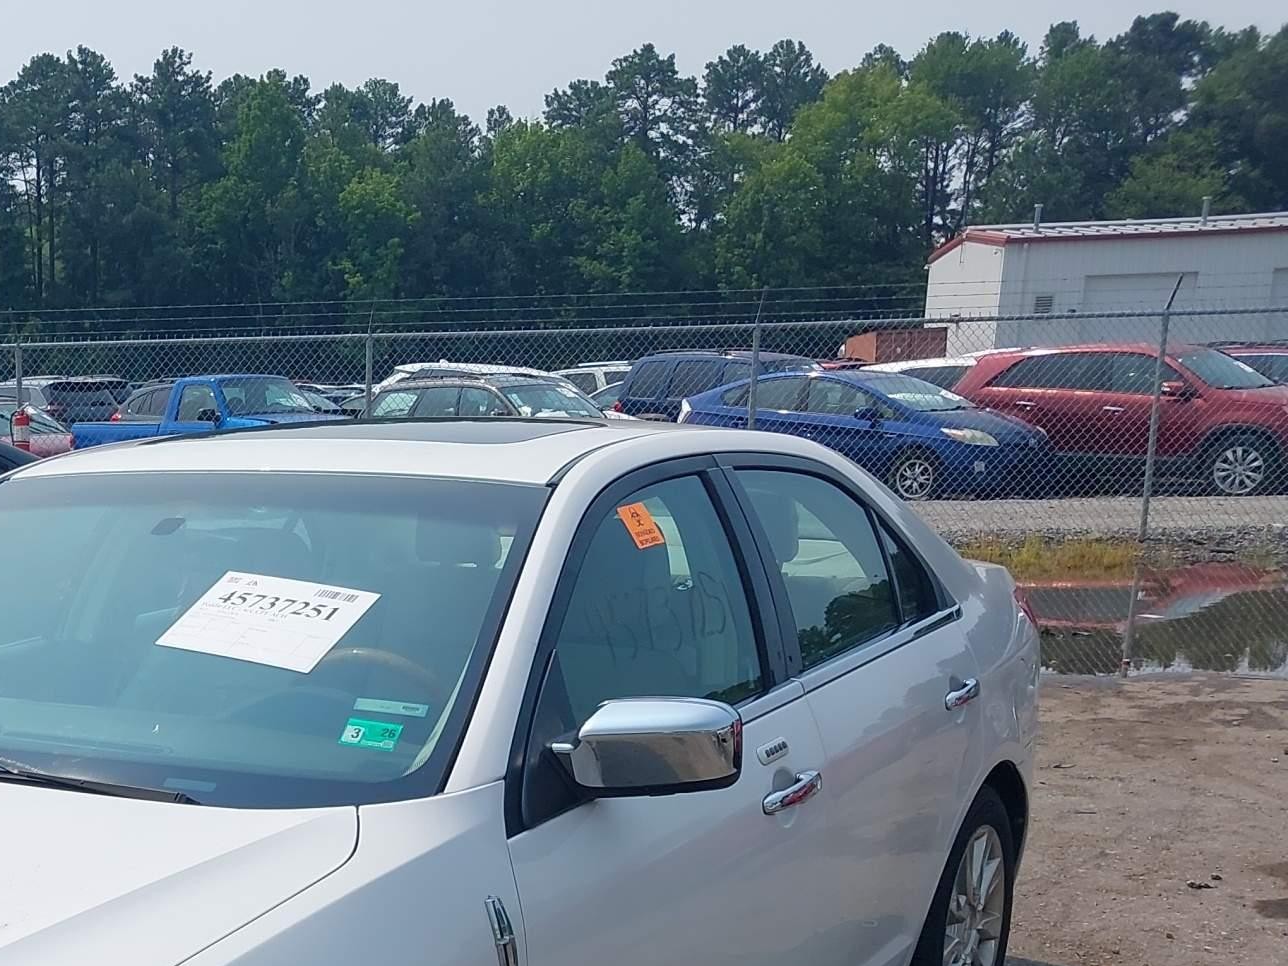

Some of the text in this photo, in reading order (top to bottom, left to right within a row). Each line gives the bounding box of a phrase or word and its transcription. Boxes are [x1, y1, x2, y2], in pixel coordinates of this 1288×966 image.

[218, 589, 340, 622] 45737251
[351, 727, 397, 739] 3 26
